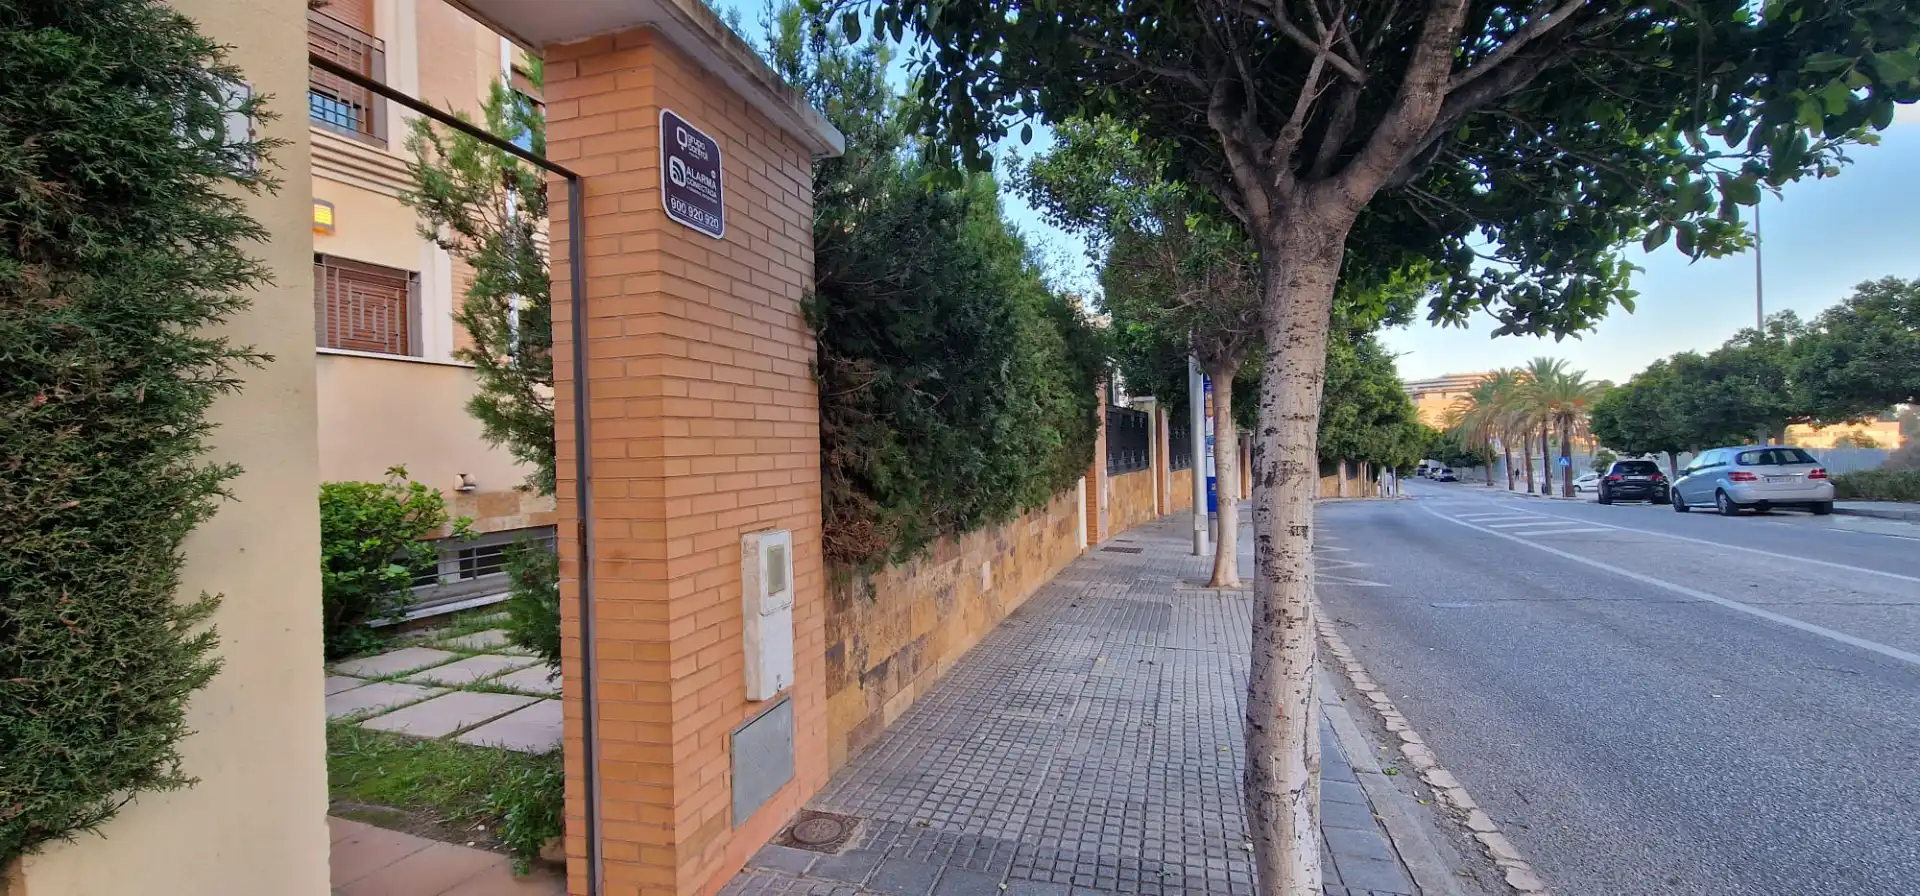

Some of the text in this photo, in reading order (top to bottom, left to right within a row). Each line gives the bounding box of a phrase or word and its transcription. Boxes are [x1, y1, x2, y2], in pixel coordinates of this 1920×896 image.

[686, 166, 717, 191] ALARMA
[686, 177, 718, 198] CONECTADA
[671, 197, 719, 229] 900 920 920
